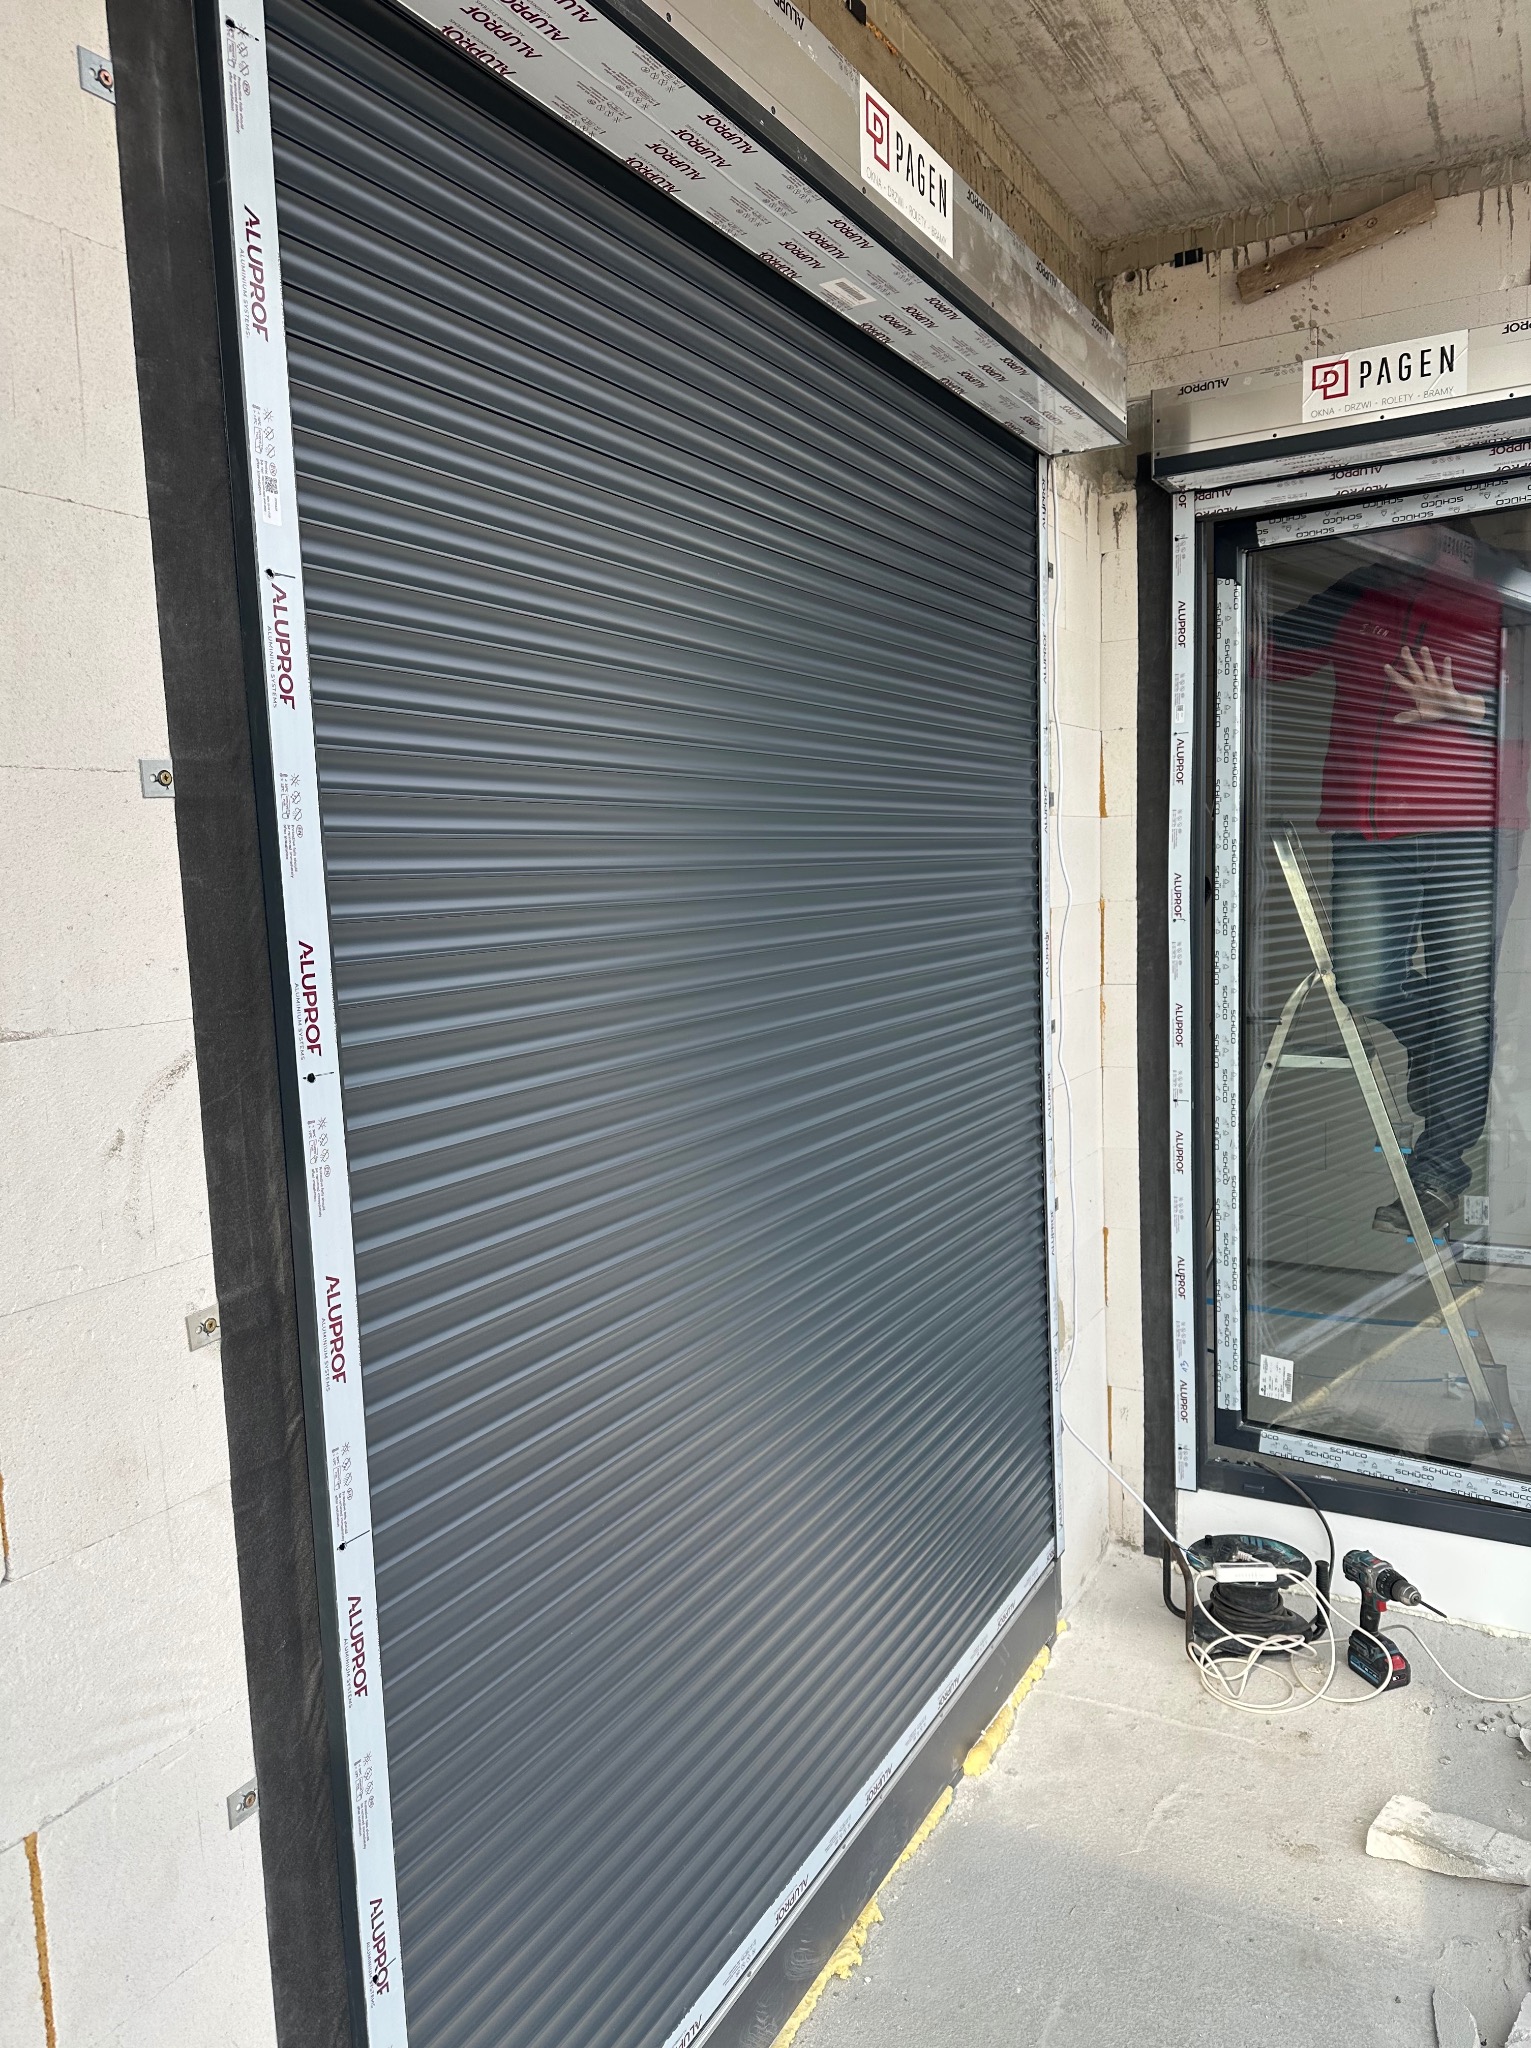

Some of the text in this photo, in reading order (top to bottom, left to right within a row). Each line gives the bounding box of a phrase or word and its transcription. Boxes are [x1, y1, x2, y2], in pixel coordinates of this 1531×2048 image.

[459, 6, 543, 58] ALUPROF
[501, 0, 570, 41] ALUPR
[441, 25, 517, 75] ALUPROF
[670, 129, 732, 168] ALUPROF
[697, 114, 758, 154] ALUPROF
[625, 157, 681, 193] ALUPROF
[645, 143, 706, 180] ALUPROF
[896, 130, 947, 218] PAGEN
[778, 241, 825, 269] ALUPROF
[802, 230, 849, 260] ALUPROF
[827, 219, 874, 249] ALUPROF
[239, 248, 247, 299] ALUMINIUM
[243, 203, 269, 343] ALUPROF
[878, 314, 917, 336] ALUPROF
[901, 306, 939, 329] ALUPROF
[924, 297, 962, 320] ALUPROF
[1178, 377, 1230, 396] ALUPROF
[1360, 344, 1455, 388] PAGEN
[1310, 386, 1454, 418] OKNA DRZWI ROLETY BRAMY
[1489, 442, 1531, 456] UPROF
[1329, 465, 1383, 480] ALUPROF
[271, 582, 296, 711] ALUPROF
[1178, 600, 1186, 649] ALUPROF
[267, 625, 278, 709] ALUMINIUM SYSTEMS
[1176, 738, 1185, 786] ALUPROF
[1173, 872, 1182, 918] ALUPROF
[298, 940, 322, 1057] ALUPROF
[1175, 1003, 1184, 1048] ALUPROF
[1175, 1130, 1184, 1175] ALUPROF
[1177, 1256, 1186, 1300] ALUPROF
[325, 1275, 347, 1384] ALUPROF
[1179, 1379, 1188, 1423] ALUPROF
[347, 1596, 368, 1697] ALUPROF
[774, 1874, 809, 1927] ALUPROF
[369, 1897, 390, 1996] ALUPROF
